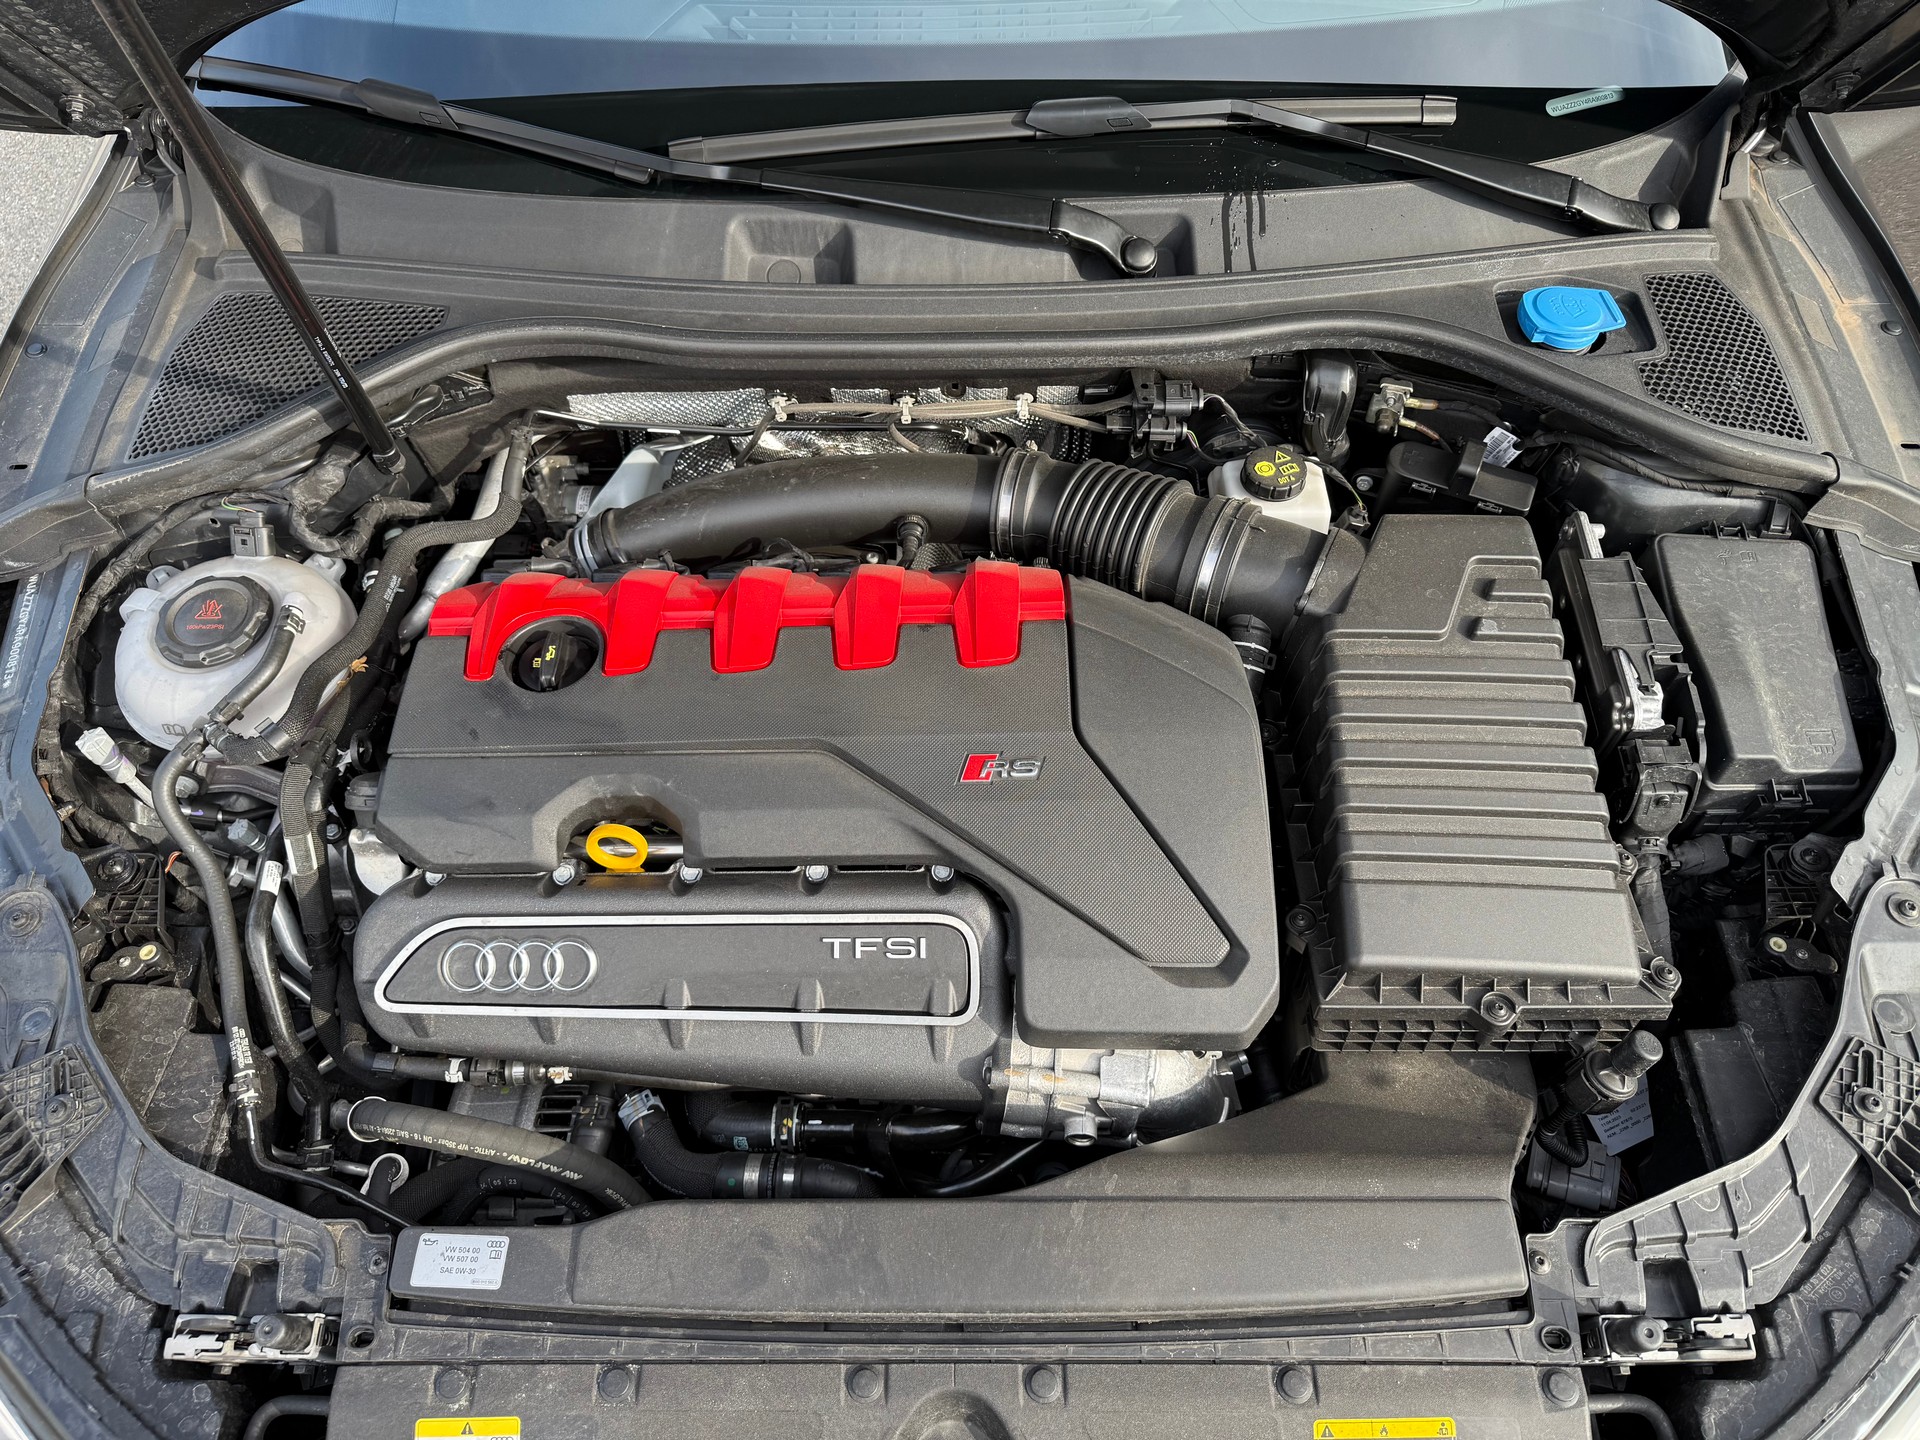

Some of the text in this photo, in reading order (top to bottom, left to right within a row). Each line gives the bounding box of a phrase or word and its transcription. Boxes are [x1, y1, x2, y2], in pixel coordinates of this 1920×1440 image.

[1550, 92, 1615, 113] WUAZZZGY4RA900813
[975, 758, 1042, 779] RS
[822, 936, 927, 959] TFSI
[445, 1246, 458, 1254] VW
[439, 1266, 477, 1275] SAE 0W-30
